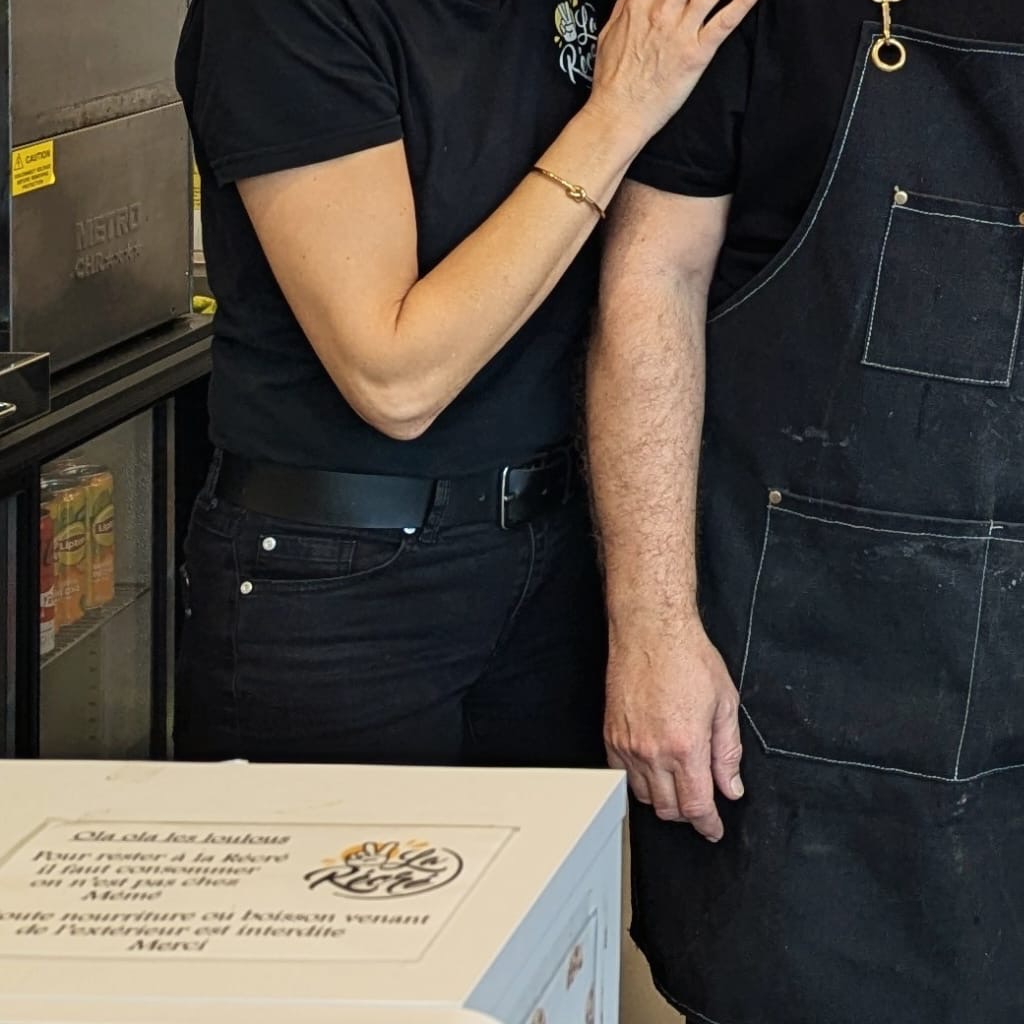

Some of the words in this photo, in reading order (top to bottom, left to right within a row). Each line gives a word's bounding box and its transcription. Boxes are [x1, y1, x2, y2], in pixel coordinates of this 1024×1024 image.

[72, 830, 116, 842] Ola
[122, 831, 158, 842] ola
[162, 832, 196, 844] les
[203, 832, 291, 844] loulous
[32, 850, 92, 862] Pour
[96, 852, 166, 862] rester
[194, 852, 214, 862] la
[36, 864, 56, 875] il
[61, 864, 110, 875] faut
[116, 865, 262, 875] consommer
[30, 878, 62, 887] on
[132, 878, 176, 889] pas
[182, 876, 240, 887] chez
[0, 910, 55, 922] oute
[61, 910, 196, 923] nourriture
[241, 909, 336, 924] boisson
[345, 912, 430, 926] venant
[16, 925, 49, 937] de
[195, 925, 230, 937] est
[236, 924, 345, 939] interdite
[127, 939, 208, 952] Merci
